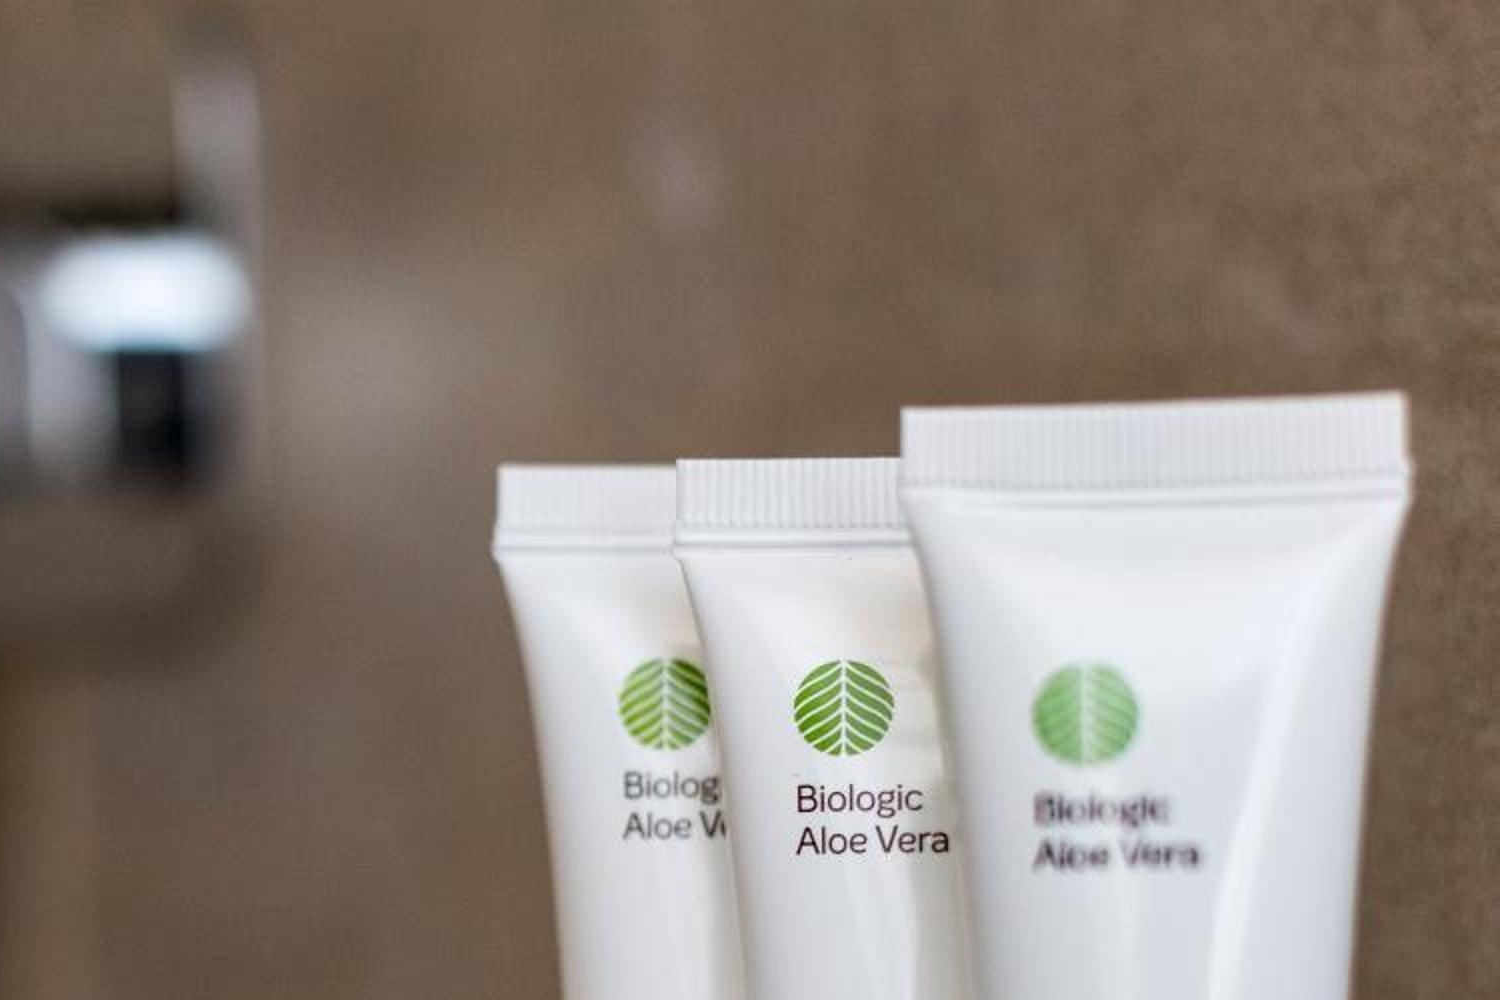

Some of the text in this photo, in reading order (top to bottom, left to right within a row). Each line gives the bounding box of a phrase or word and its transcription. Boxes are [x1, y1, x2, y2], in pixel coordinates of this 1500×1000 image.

[796, 783, 924, 819] Biologic
[1033, 789, 1171, 831] Biologic
[621, 811, 692, 840] Aloe
[795, 824, 950, 856] Aloe Vera
[1031, 836, 1202, 873] Aloe Vera
